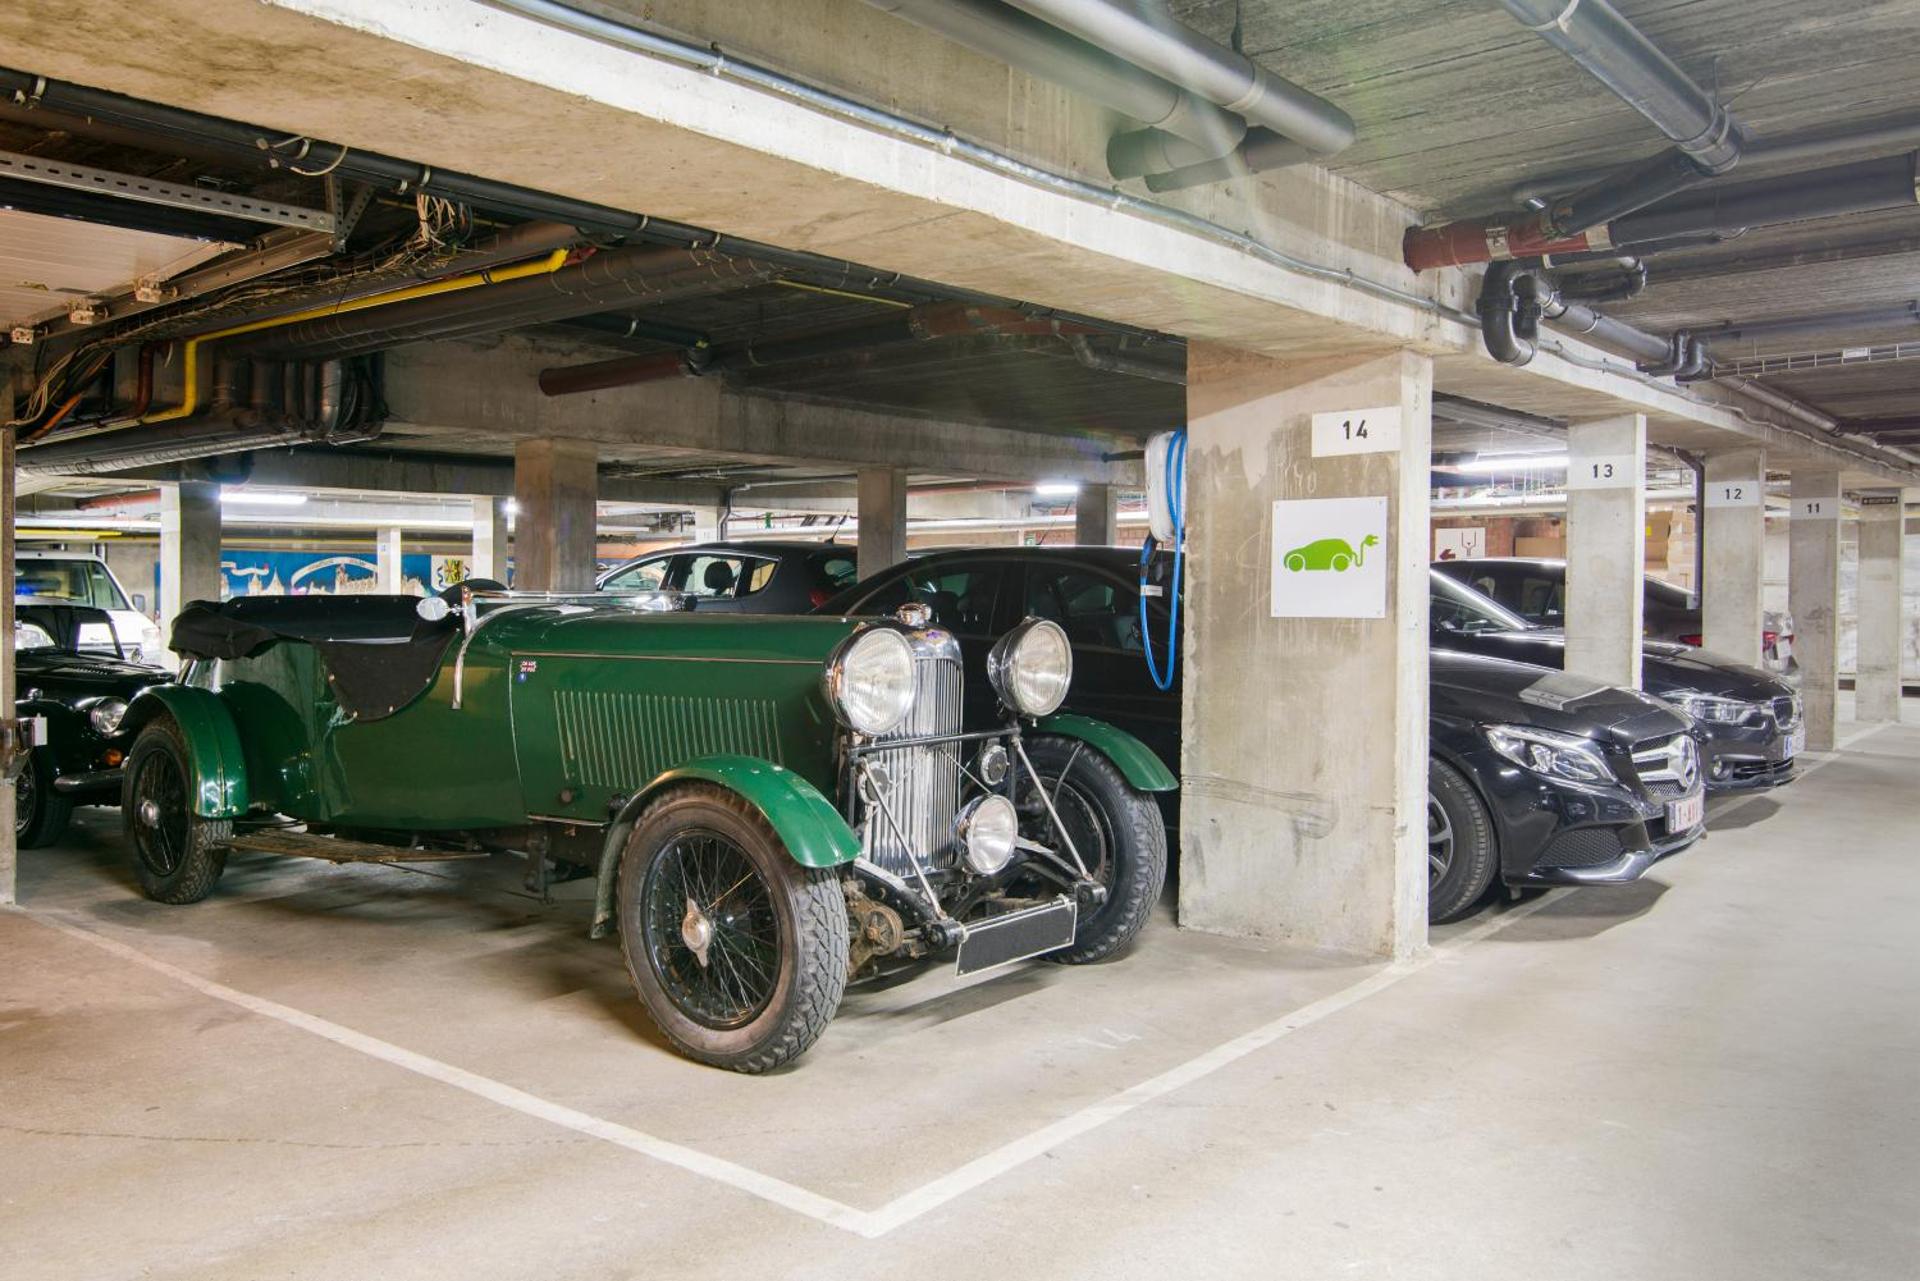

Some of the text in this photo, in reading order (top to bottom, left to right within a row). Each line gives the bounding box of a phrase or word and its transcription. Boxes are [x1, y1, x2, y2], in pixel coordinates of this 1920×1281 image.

[1343, 420, 1368, 440] 14
[1593, 464, 1613, 479] 13
[1725, 488, 1742, 500] 12
[1807, 503, 1820, 513] 11
